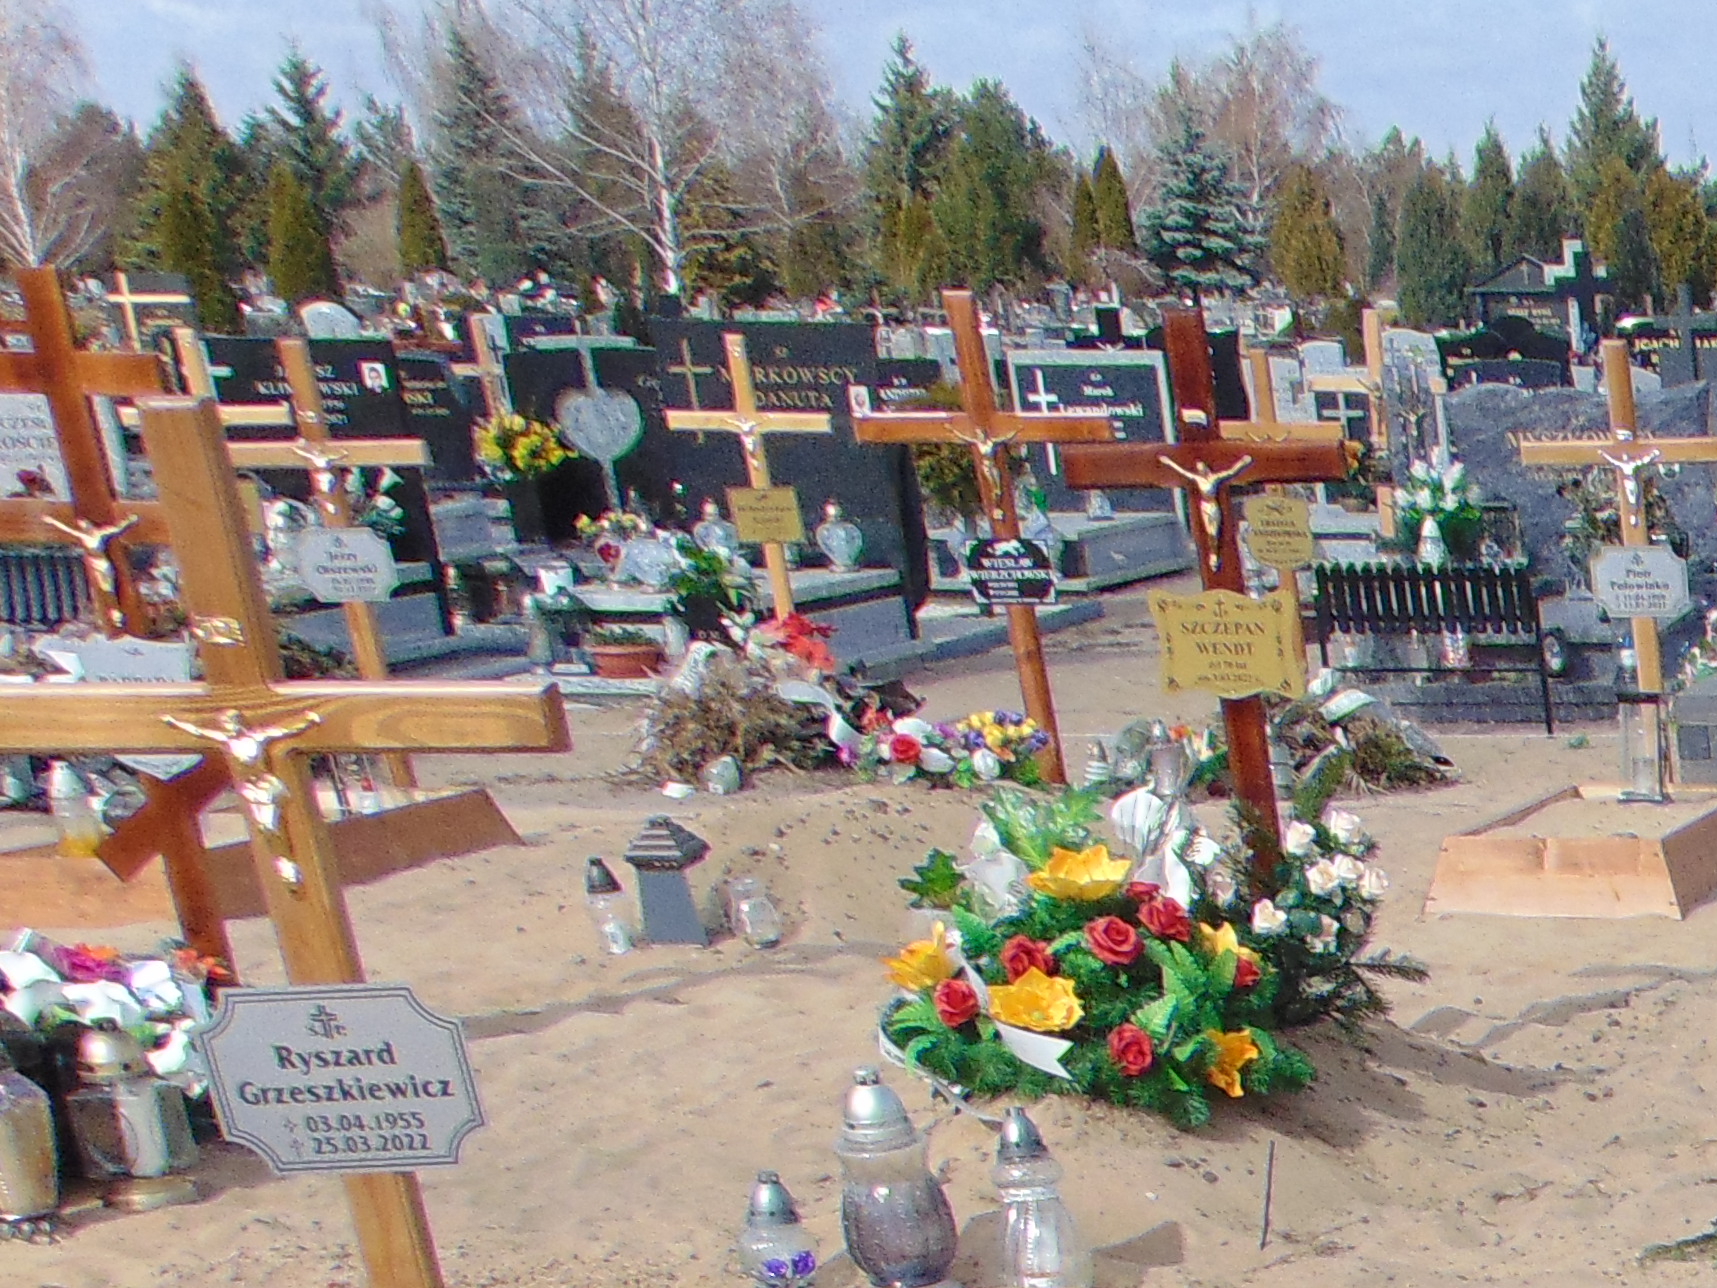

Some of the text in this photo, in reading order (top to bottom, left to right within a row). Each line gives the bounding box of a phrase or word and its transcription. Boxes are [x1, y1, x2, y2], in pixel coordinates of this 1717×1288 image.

[1181, 622, 1266, 635] SZCZEPAN
[271, 1041, 398, 1075] Ryszard
[239, 1075, 455, 1106] Grzeszkiewicz
[306, 1111, 426, 1132] 03.04.1955
[312, 1133, 432, 1154] 25.03.2022
